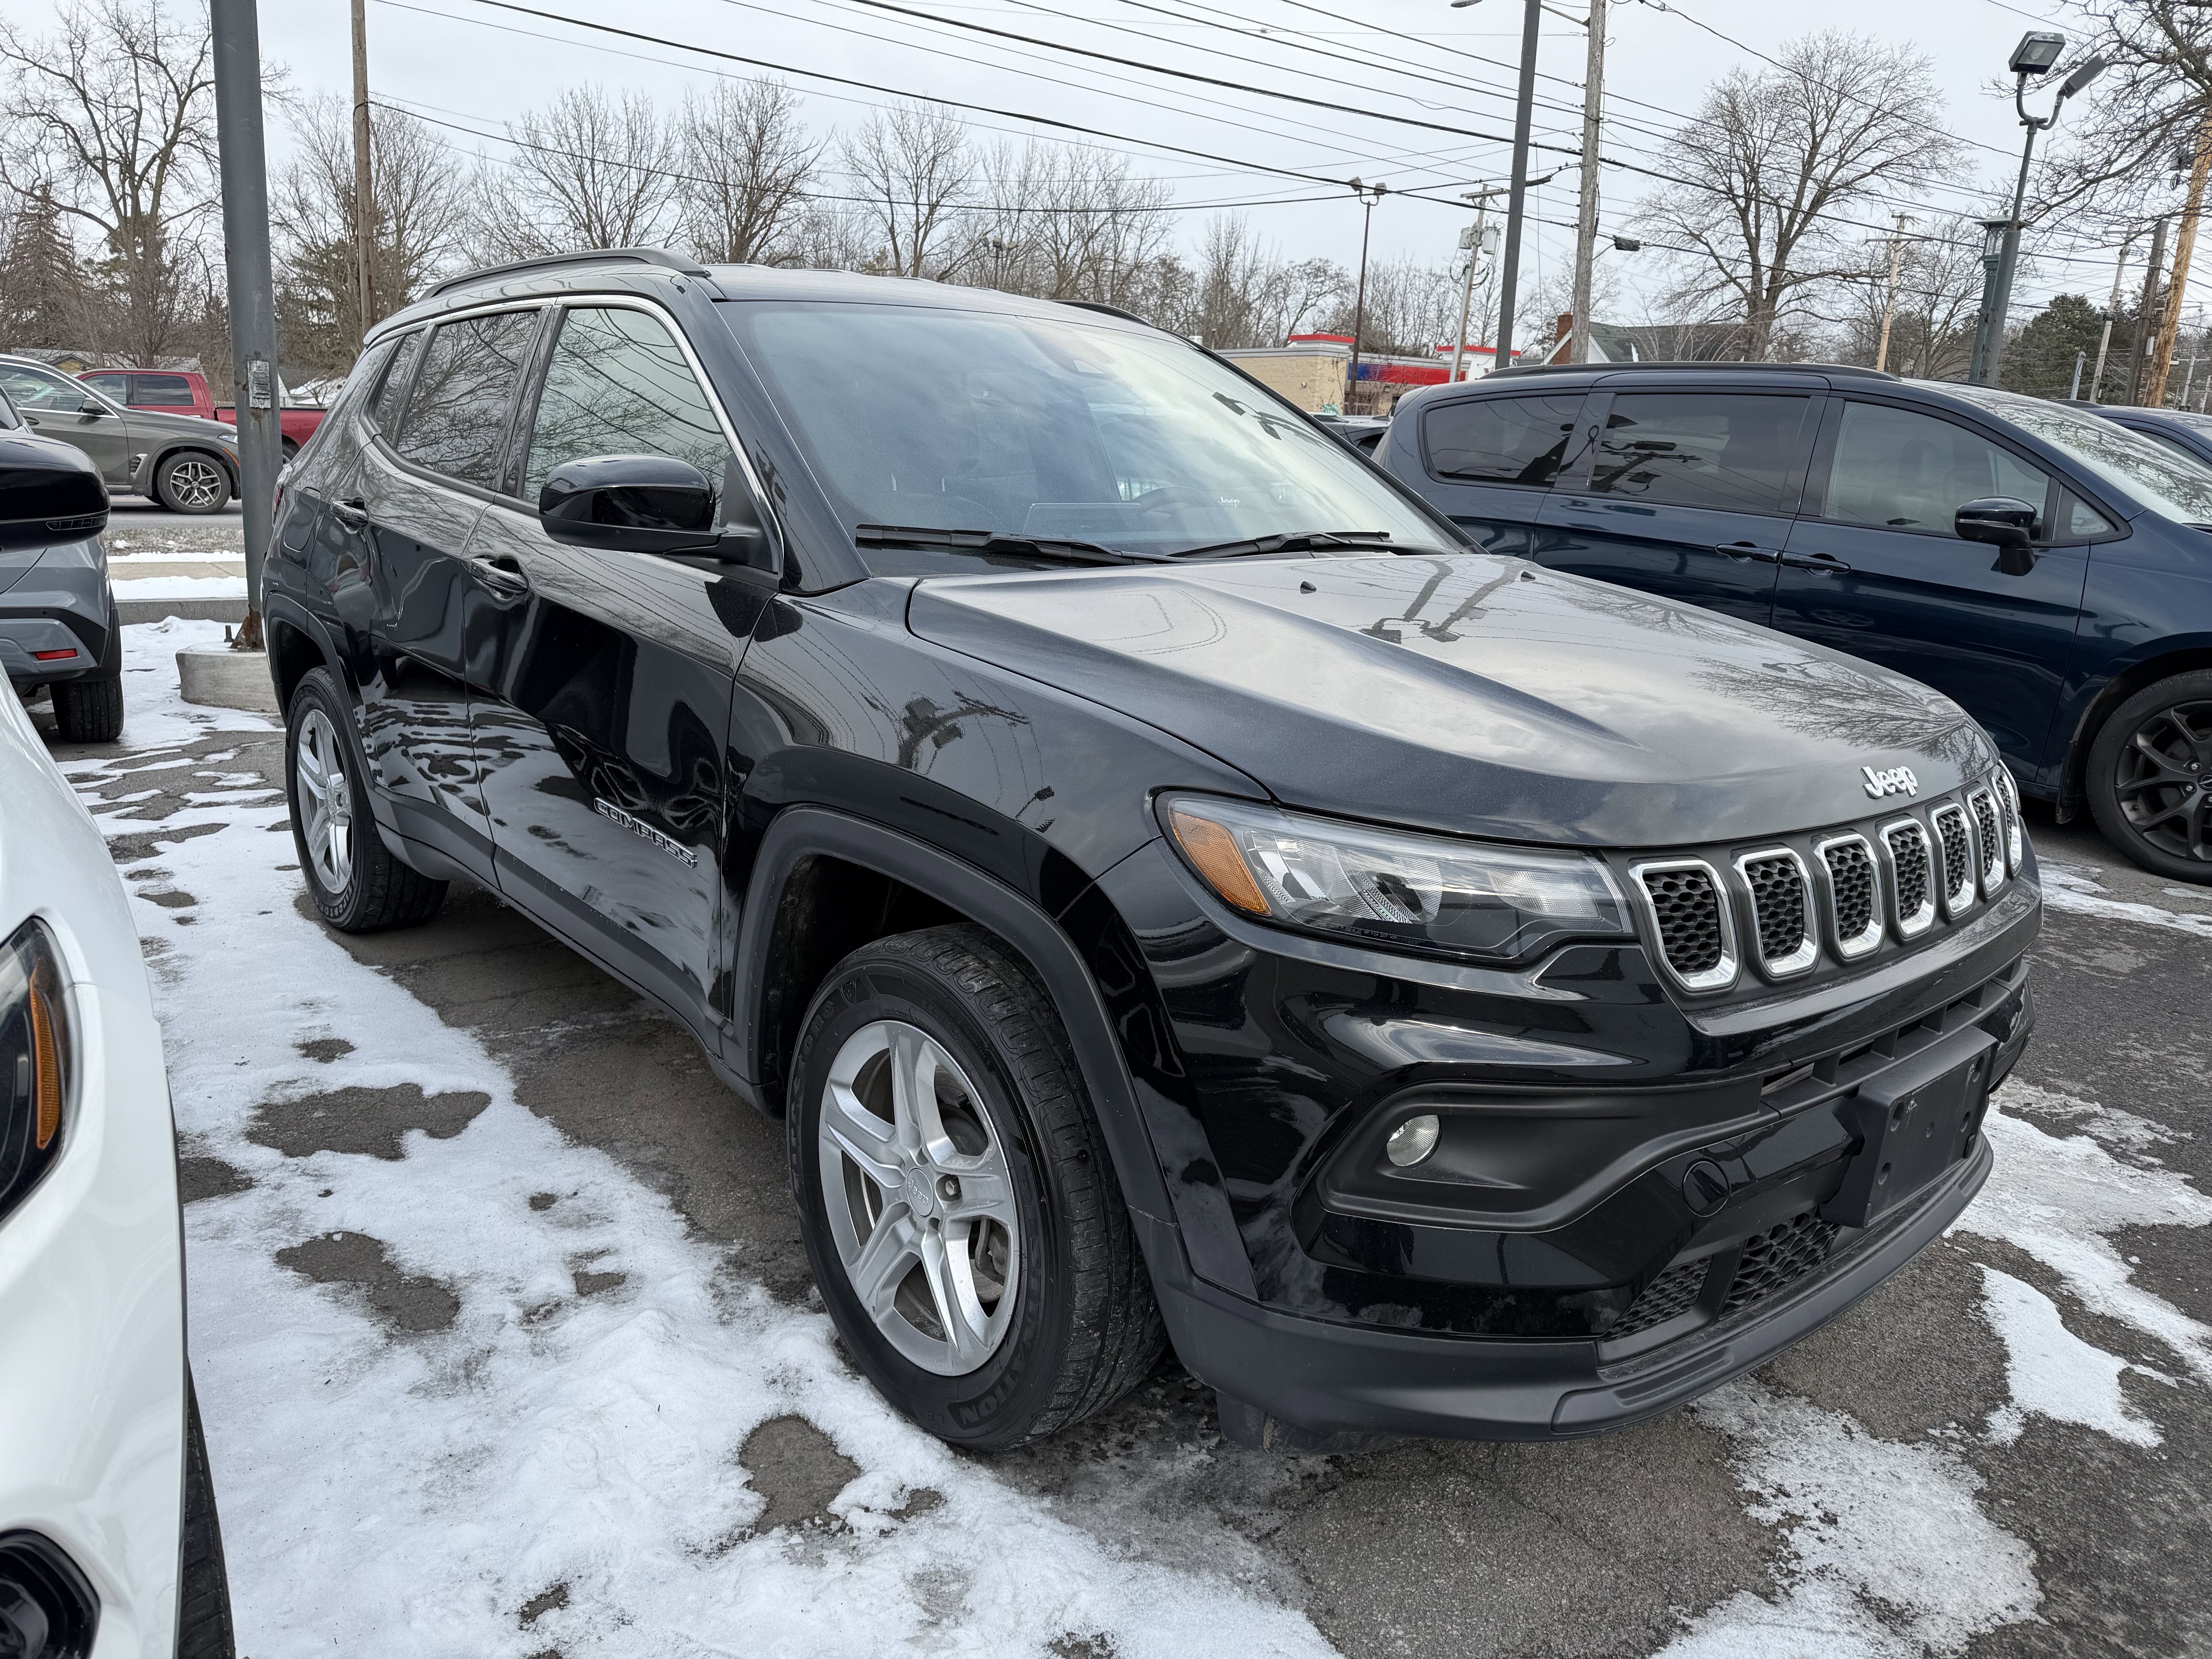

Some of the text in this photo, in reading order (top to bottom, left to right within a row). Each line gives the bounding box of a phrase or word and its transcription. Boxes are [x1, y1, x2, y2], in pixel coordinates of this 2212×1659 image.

[1218, 496, 1240, 508] Jeep
[1860, 766, 1918, 799] Jeep
[594, 797, 697, 868] COMPASS
[908, 1180, 929, 1206] Jeep
[959, 1164, 1042, 1425] DESTINATION
